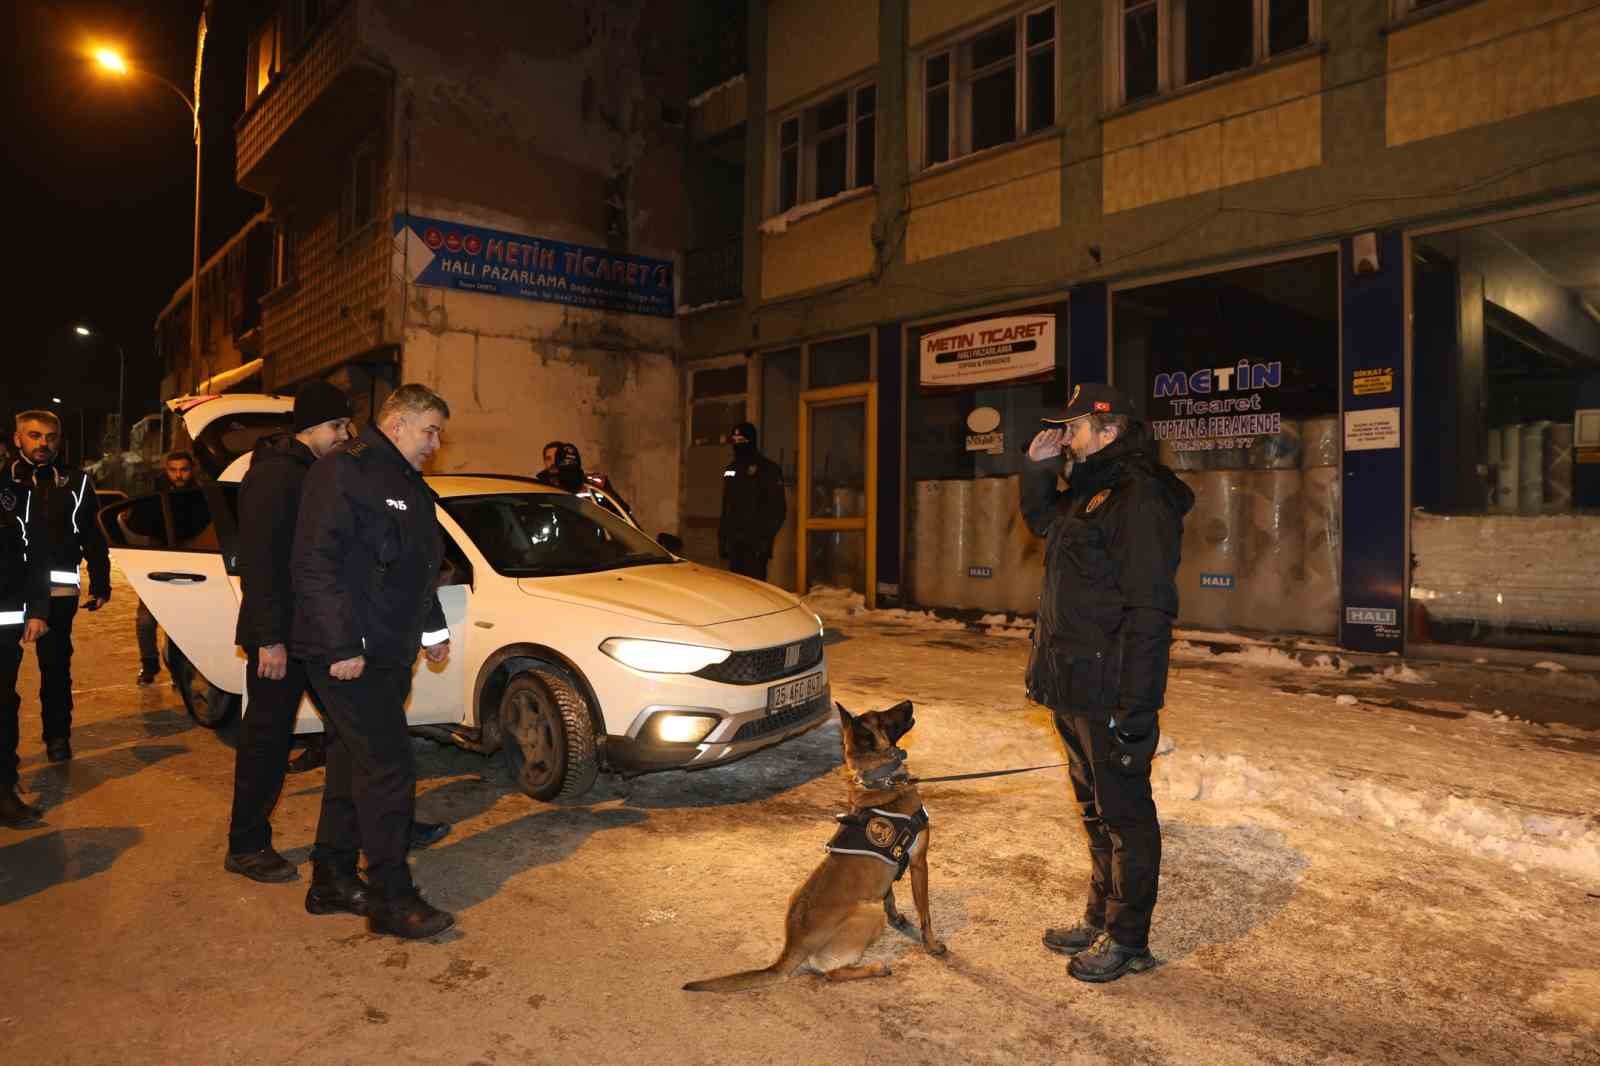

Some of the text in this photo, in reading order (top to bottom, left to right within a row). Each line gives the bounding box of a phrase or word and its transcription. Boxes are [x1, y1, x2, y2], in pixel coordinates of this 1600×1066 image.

[441, 258, 476, 277] HALI
[482, 263, 567, 289] PAZARLAMA
[1153, 358, 1282, 398] METİN
[1170, 392, 1262, 416] Ticaret
[1152, 412, 1281, 441] TOPTAN & PERAKENDE
[1202, 576, 1231, 587] HALI
[1351, 611, 1391, 622] HALI
